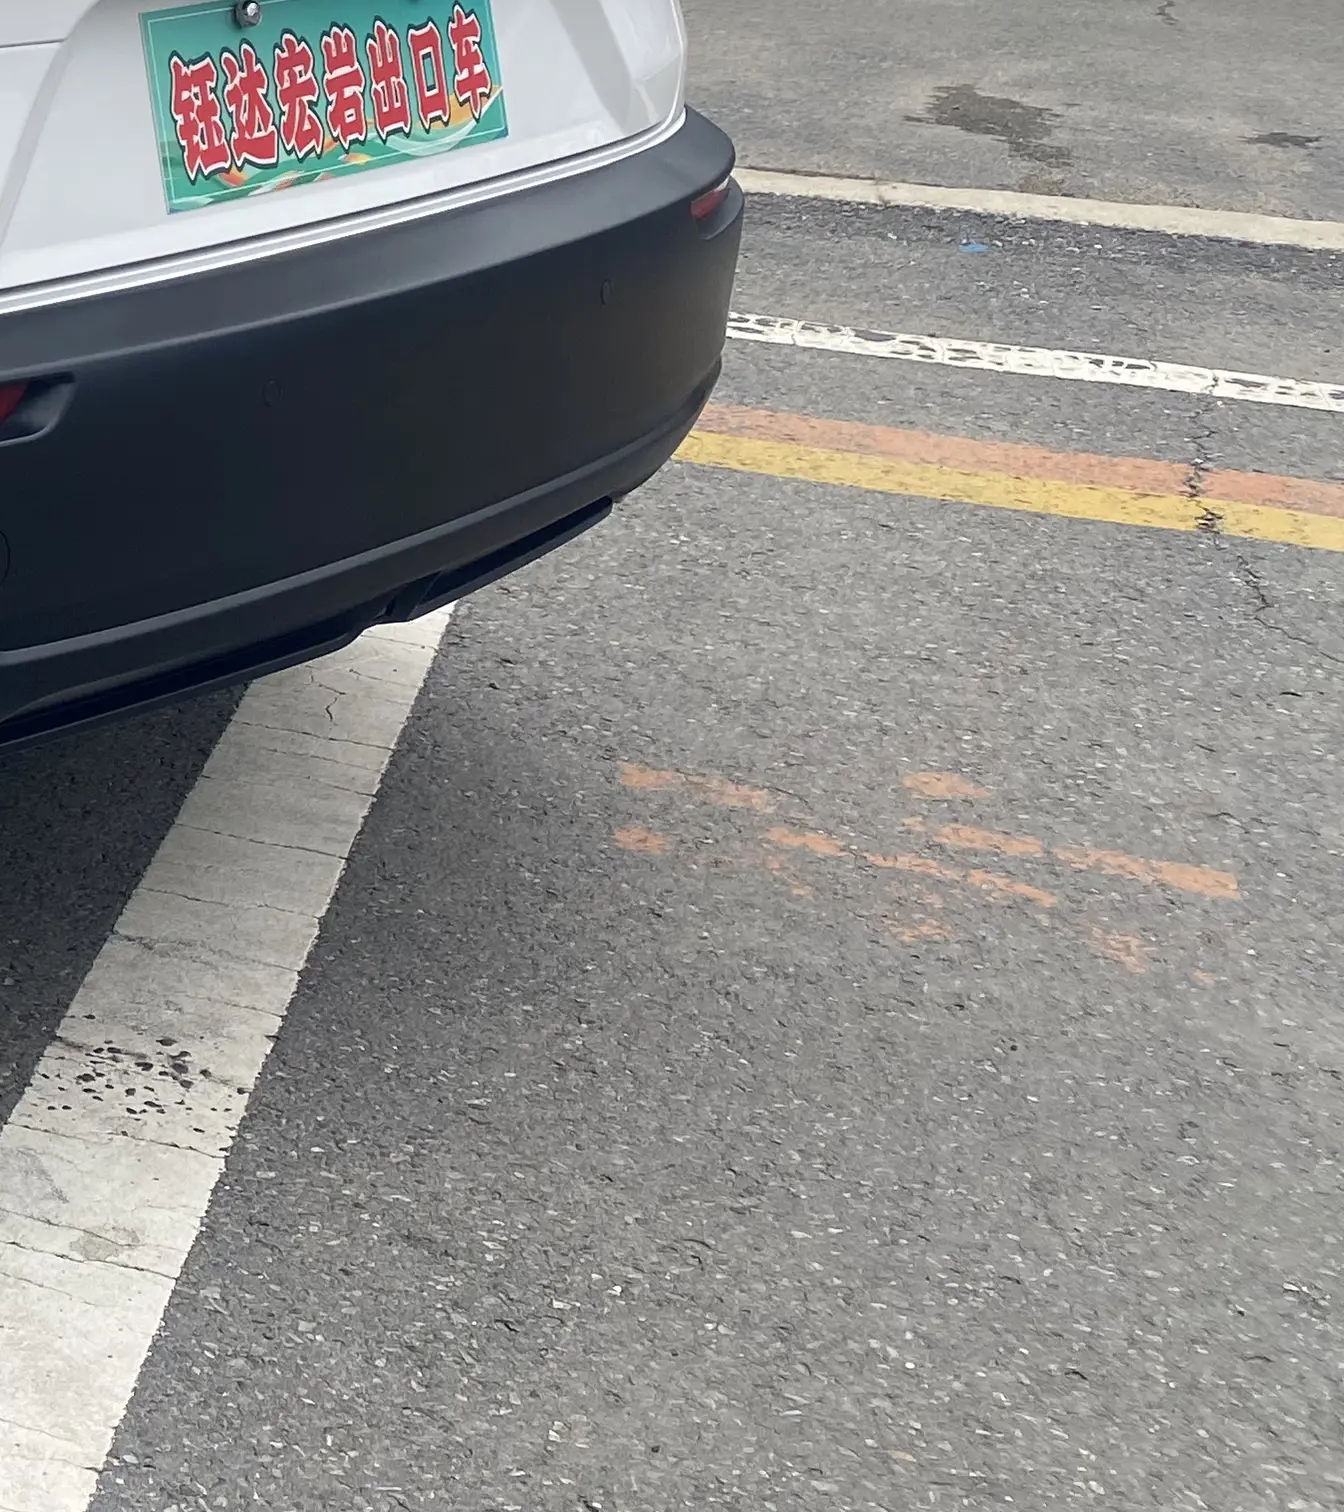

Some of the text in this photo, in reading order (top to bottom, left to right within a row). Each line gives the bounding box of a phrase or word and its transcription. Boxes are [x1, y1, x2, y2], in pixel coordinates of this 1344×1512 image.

[168, 0, 493, 185] 钰达宏岩出口车
